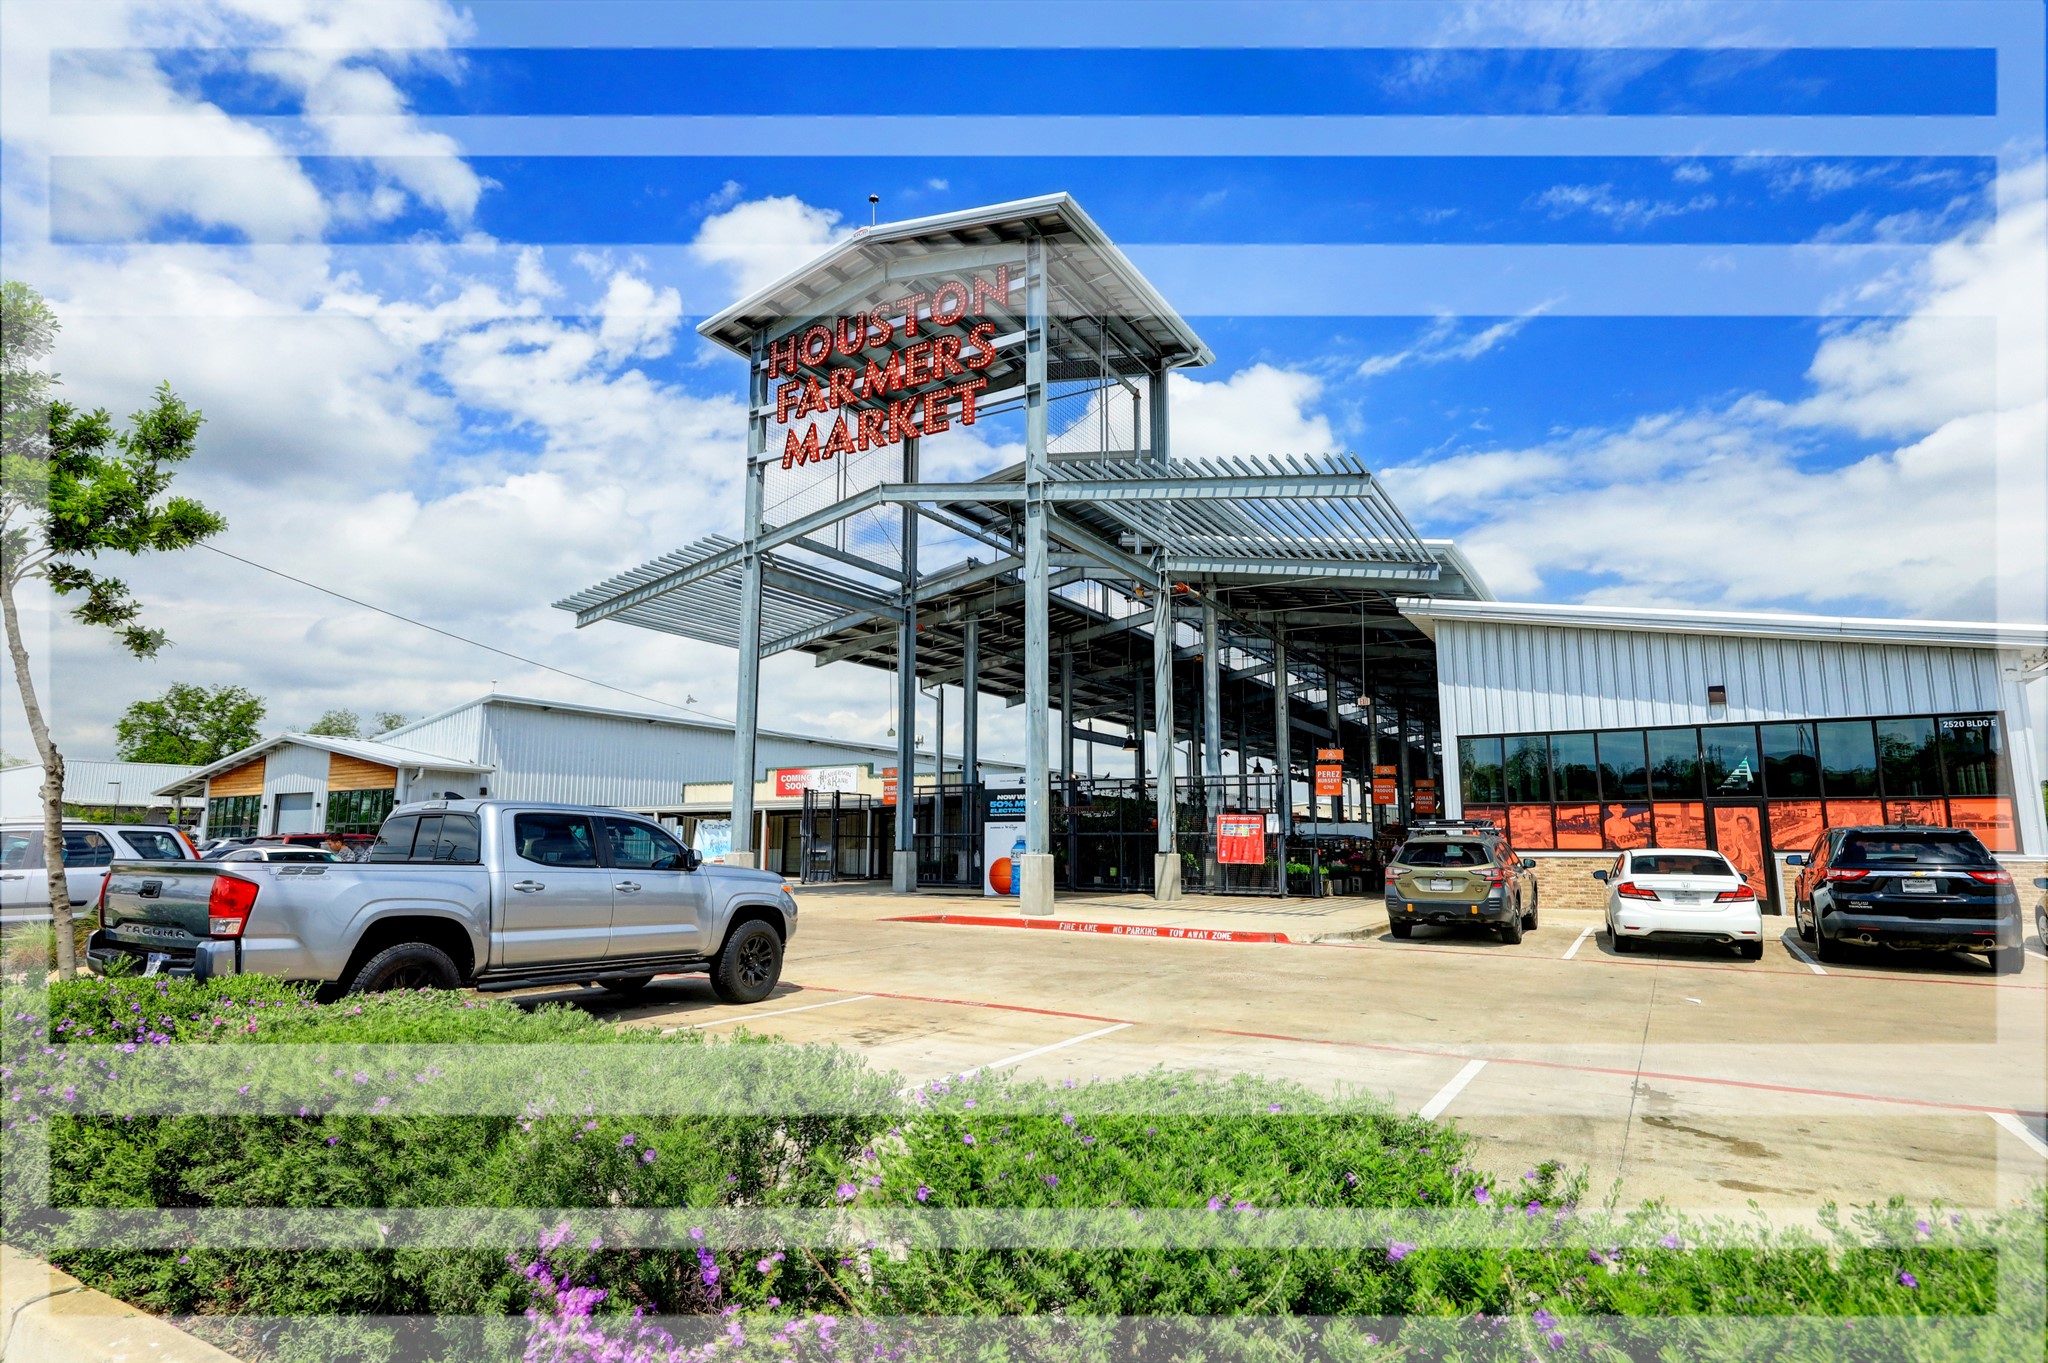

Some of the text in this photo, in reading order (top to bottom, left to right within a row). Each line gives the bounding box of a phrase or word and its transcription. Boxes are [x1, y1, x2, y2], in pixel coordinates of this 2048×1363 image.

[768, 264, 1009, 379] HOUSTON
[777, 322, 997, 424] FARMERS
[782, 377, 987, 470] MARKET
[1943, 719, 1997, 729] 2520 BLDG E
[781, 774, 812, 783] COMING
[1317, 770, 1340, 778] PEREZ
[785, 782, 807, 790] SOON
[124, 925, 186, 939] TACOMA
[1059, 922, 1233, 941] FIRE LANE NO PARKING TOW AWAY ZONE
